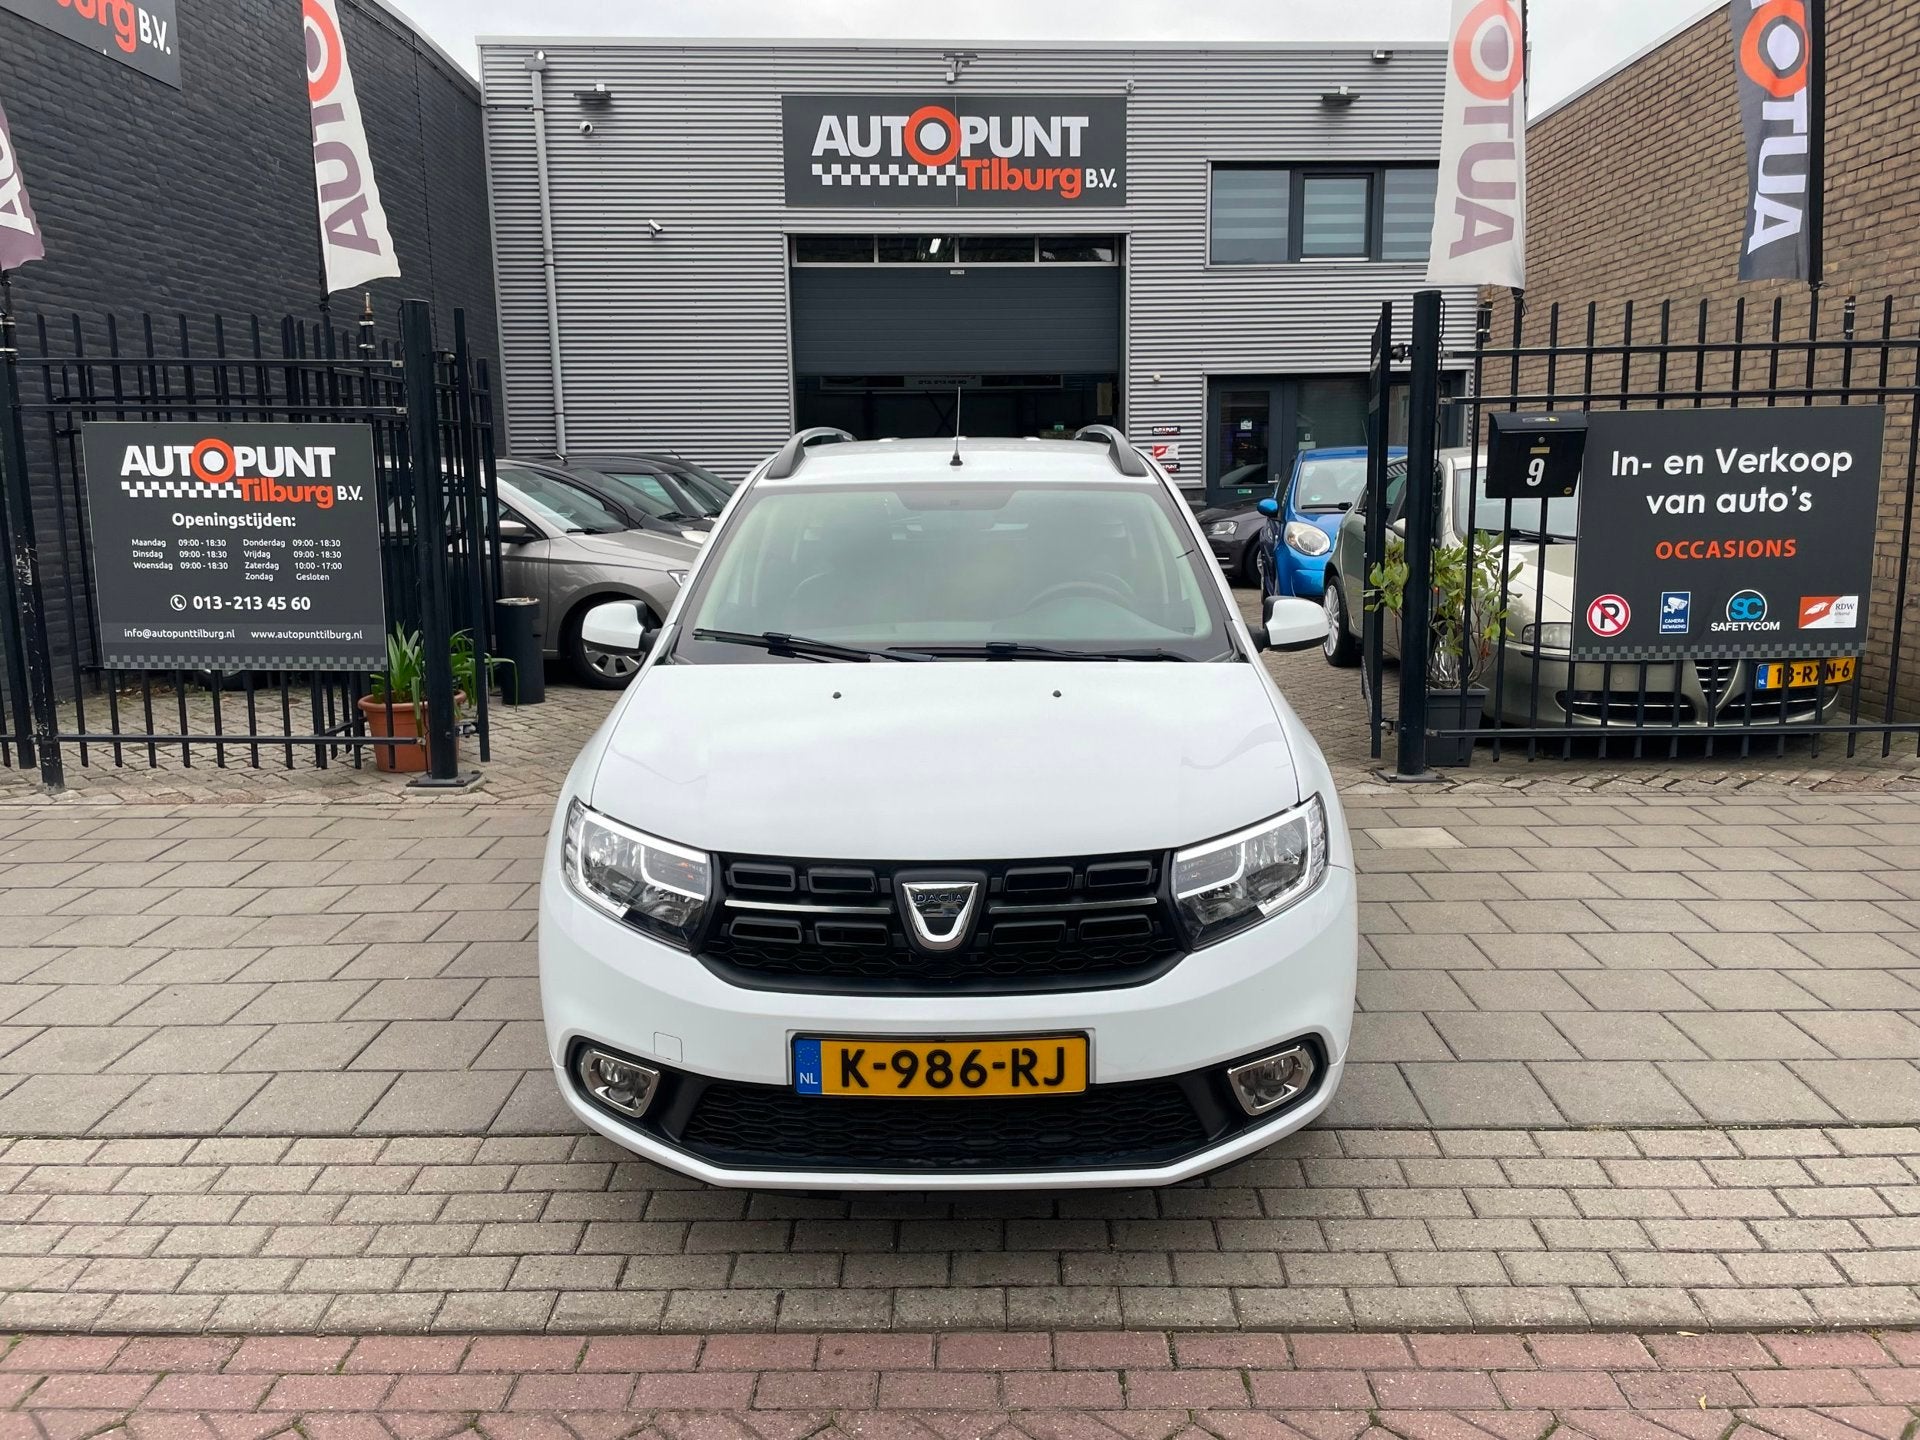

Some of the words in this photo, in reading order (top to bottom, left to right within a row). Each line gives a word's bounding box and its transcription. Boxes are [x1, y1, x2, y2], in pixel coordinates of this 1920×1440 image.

[138, 8, 171, 55] B.V.
[811, 105, 1089, 167] AUTOPUNT
[961, 157, 1082, 199] Tilburg
[1085, 168, 1118, 189] B.V.
[120, 438, 336, 484] AUTOPUNT
[1611, 451, 1652, 476] In-
[1663, 454, 1704, 475] en
[1715, 446, 1853, 478] Verkoop
[1526, 458, 1545, 487] 9
[237, 477, 334, 509] Tilburg
[336, 485, 363, 501] B.V.
[1646, 494, 1706, 515] van
[172, 512, 296, 530] Openingstijden:
[131, 539, 167, 548] Maandag
[178, 539, 199, 547] 09:00
[205, 539, 227, 547] 18:30
[243, 538, 286, 548] Donderdag
[292, 539, 314, 547] 09:00
[320, 539, 341, 547] 18:30
[1655, 539, 1797, 560] OCCASIONS
[132, 550, 163, 559] Dinsdag
[179, 550, 200, 558] 09:00
[207, 550, 228, 558] 18:30
[243, 550, 271, 559] Vrijdag
[293, 551, 315, 559] 09:00
[321, 551, 342, 559] 18:30
[133, 561, 173, 570] Woensdag
[180, 562, 201, 570] 09:00
[207, 562, 229, 570] 18:30
[244, 561, 280, 571] Zaterdag
[294, 562, 316, 570] 10:00
[322, 562, 343, 570] 17:00
[245, 573, 274, 581] Zondag
[296, 573, 330, 581] Gesloten
[267, 596, 287, 610] 45
[291, 596, 311, 610] 60
[1730, 597, 1763, 620] SC
[1835, 603, 1855, 611] RDW
[1710, 621, 1781, 632] SAFETYCOM
[124, 628, 236, 641] info@autopunttilburg.nl
[251, 630, 363, 642] www.autopunttilburg.nl
[914, 892, 965, 903] DACIA
[800, 1072, 818, 1085] NL
[841, 1046, 1065, 1089] K-986-RJ
